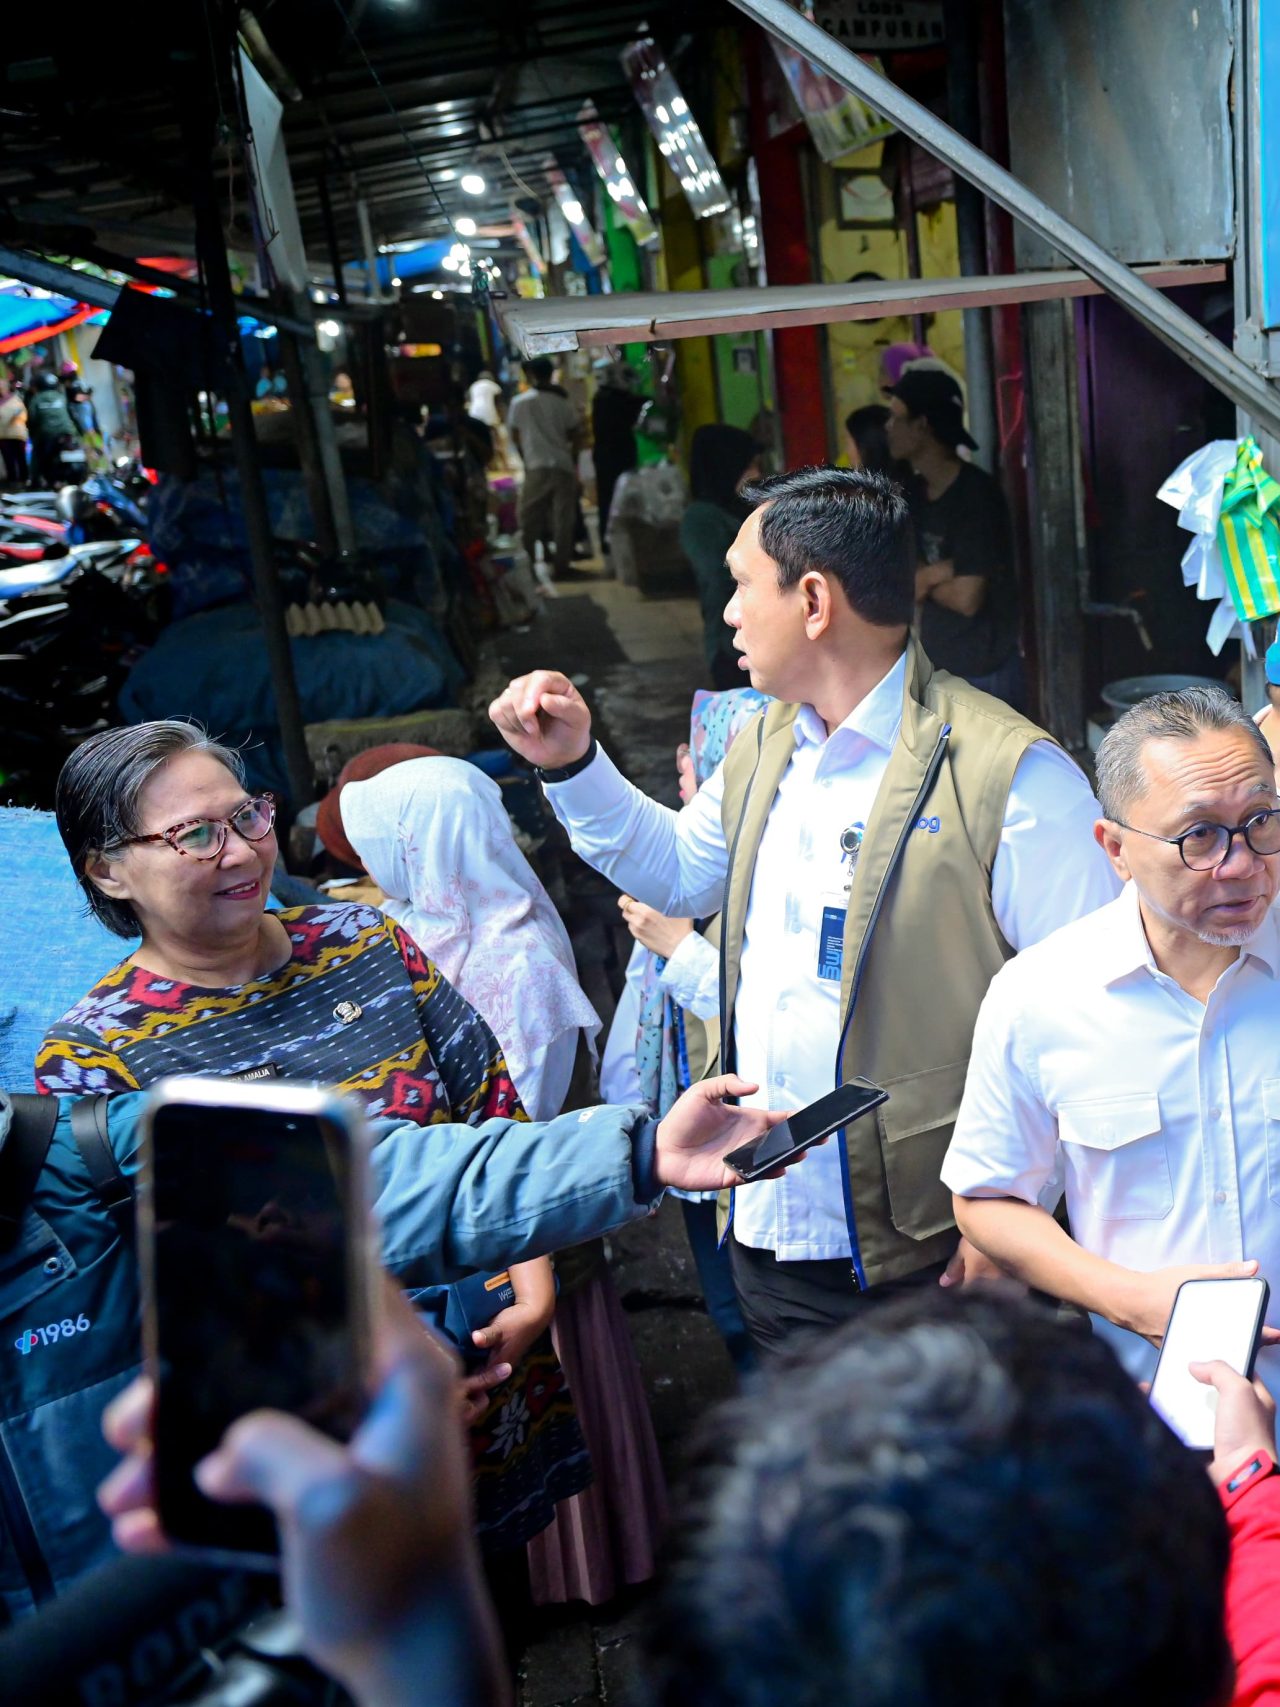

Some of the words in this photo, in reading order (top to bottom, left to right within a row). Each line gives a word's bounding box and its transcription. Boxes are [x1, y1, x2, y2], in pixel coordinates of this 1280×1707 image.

[822, 18, 943, 38] CAMPURAN
[917, 815, 941, 833] og
[244, 1068, 270, 1081] AMALIA
